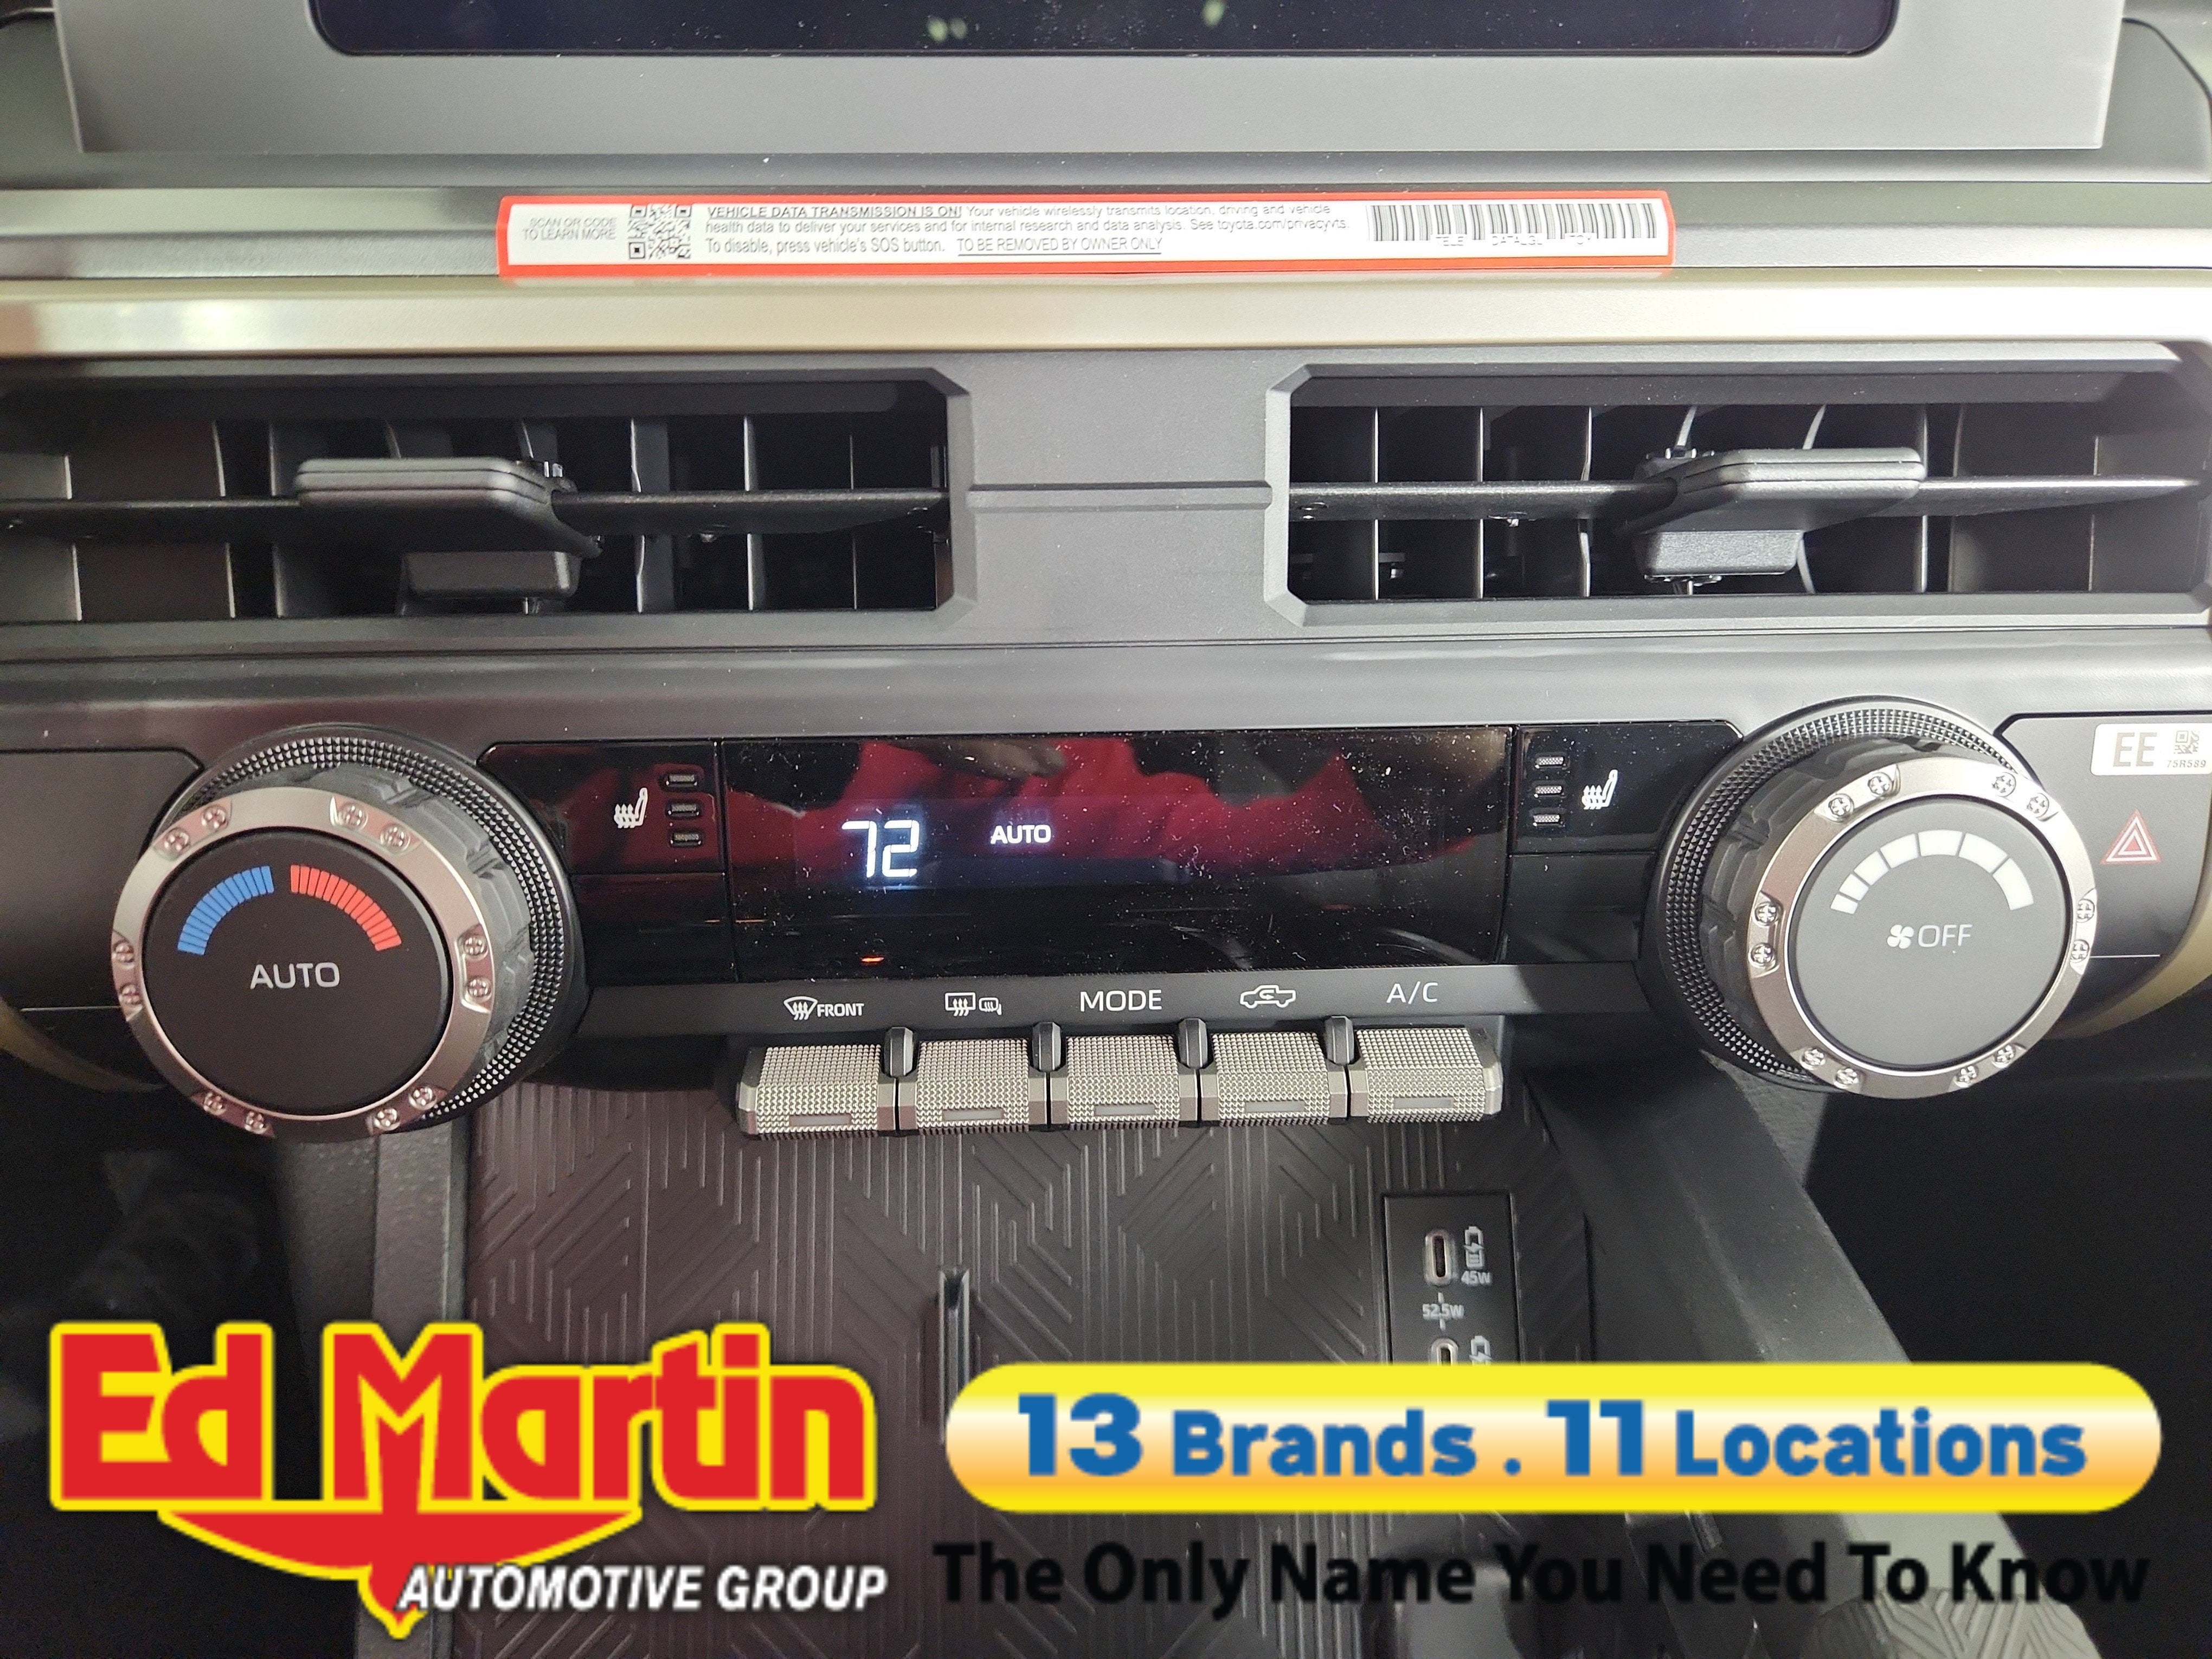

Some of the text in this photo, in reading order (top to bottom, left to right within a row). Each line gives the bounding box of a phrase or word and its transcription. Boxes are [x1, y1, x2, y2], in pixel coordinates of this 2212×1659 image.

[707, 204, 1330, 218] VEHICLE DATA TRANSMISSION IS ON! Your vehicle wirelessly transmits location, driving and vehicle
[529, 217, 561, 227] SCAN
[584, 217, 616, 227] CODE
[705, 220, 743, 233] health
[747, 221, 774, 233] data
[779, 221, 790, 233] to
[795, 221, 835, 233] deliver
[840, 222, 866, 235] your
[870, 221, 920, 232] services
[925, 221, 947, 232] and
[951, 221, 968, 232] for
[972, 220, 1016, 232] internal
[1020, 220, 1072, 232] research
[1077, 220, 1098, 230] and
[1103, 220, 1129, 230] data
[1134, 219, 1185, 233] analysis.
[1191, 218, 1213, 230] See
[523, 228, 616, 240] TO LEARN MORE
[705, 237, 1162, 256] To disable, press vehicle's SOS button. TO BE REMOVED BY OWNER ONLY
[2113, 732, 2158, 767] EE
[2166, 760, 2207, 768] 75R589
[841, 820, 1052, 878] 72 AUTO
[1917, 924, 1972, 949] OFF
[249, 962, 342, 991] AUTO
[1079, 989, 1162, 1012] MODE
[1386, 982, 1439, 1004] A/C
[816, 1003, 865, 1017] FRONT
[1461, 1270, 1491, 1285] 45W
[1422, 1303, 1465, 1320] 52.5W
